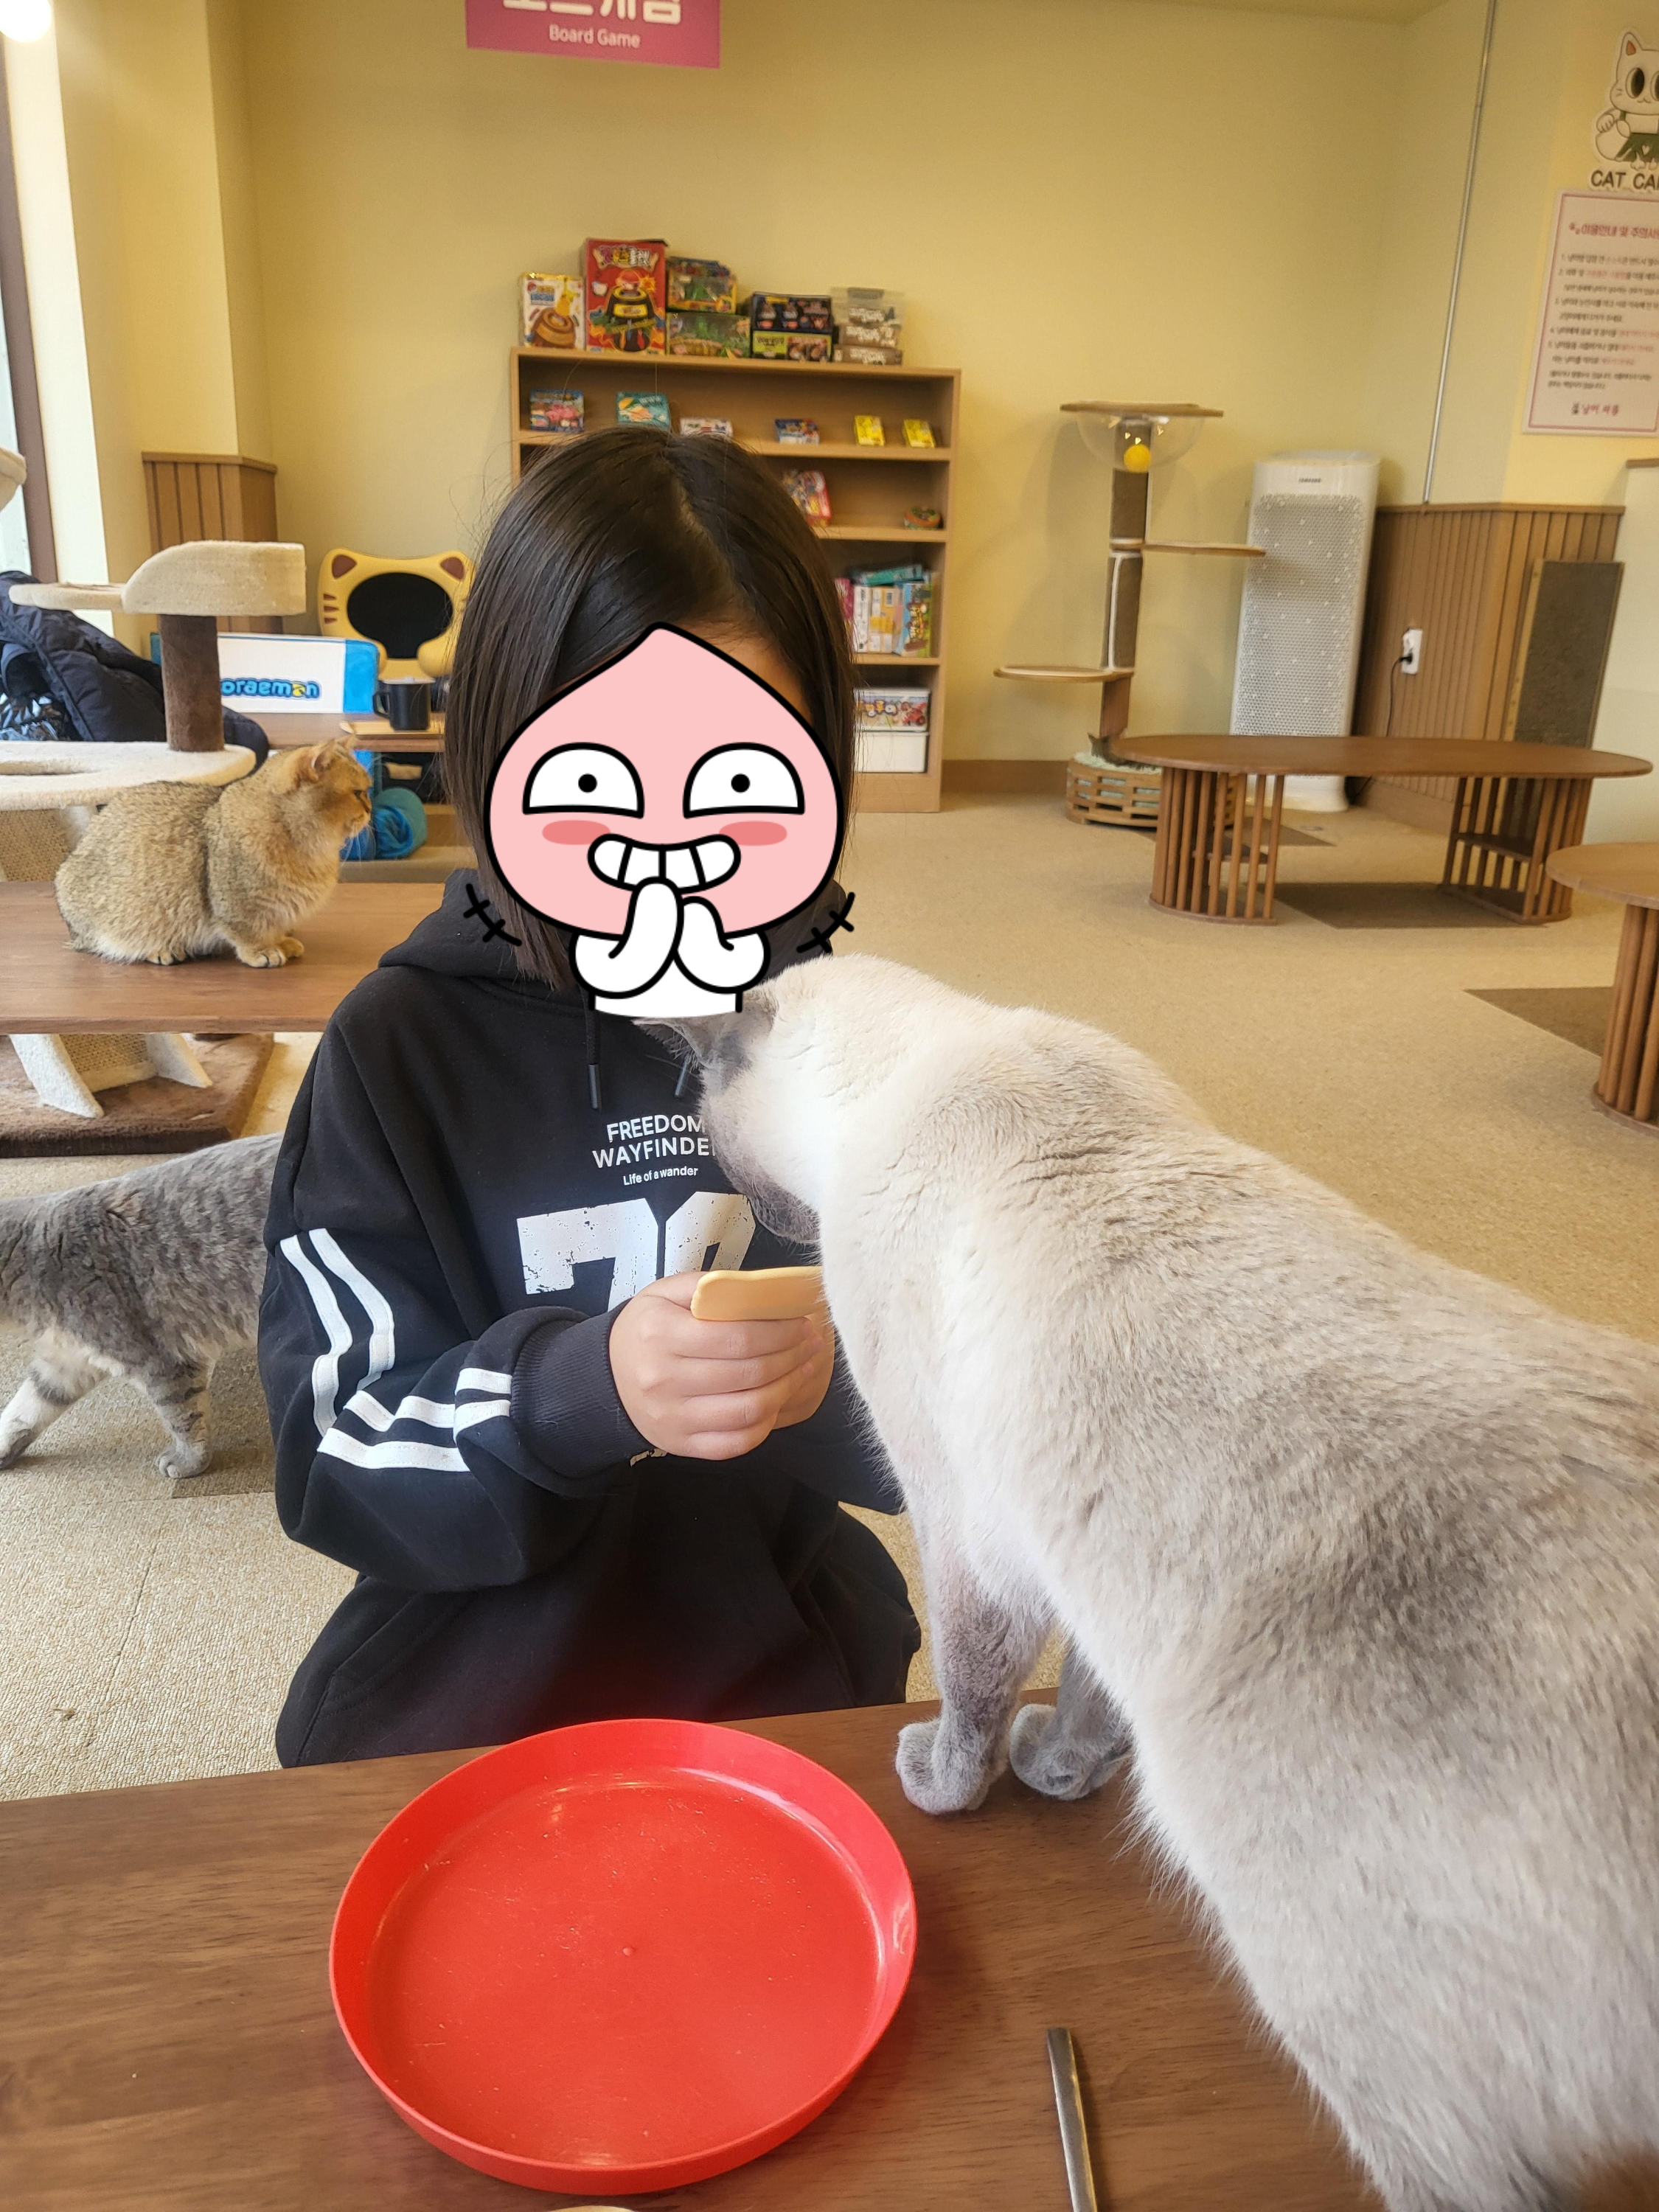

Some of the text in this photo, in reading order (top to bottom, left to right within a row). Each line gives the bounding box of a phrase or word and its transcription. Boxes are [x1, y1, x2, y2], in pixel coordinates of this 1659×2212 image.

[549, 24, 641, 49] Board Game
[1590, 170, 1659, 191] CAT CA
[220, 677, 320, 699] oraemon
[606, 1114, 706, 1143] FREEDOM
[592, 1136, 716, 1169] WAYFINDE
[622, 1166, 699, 1186] Life of a wander
